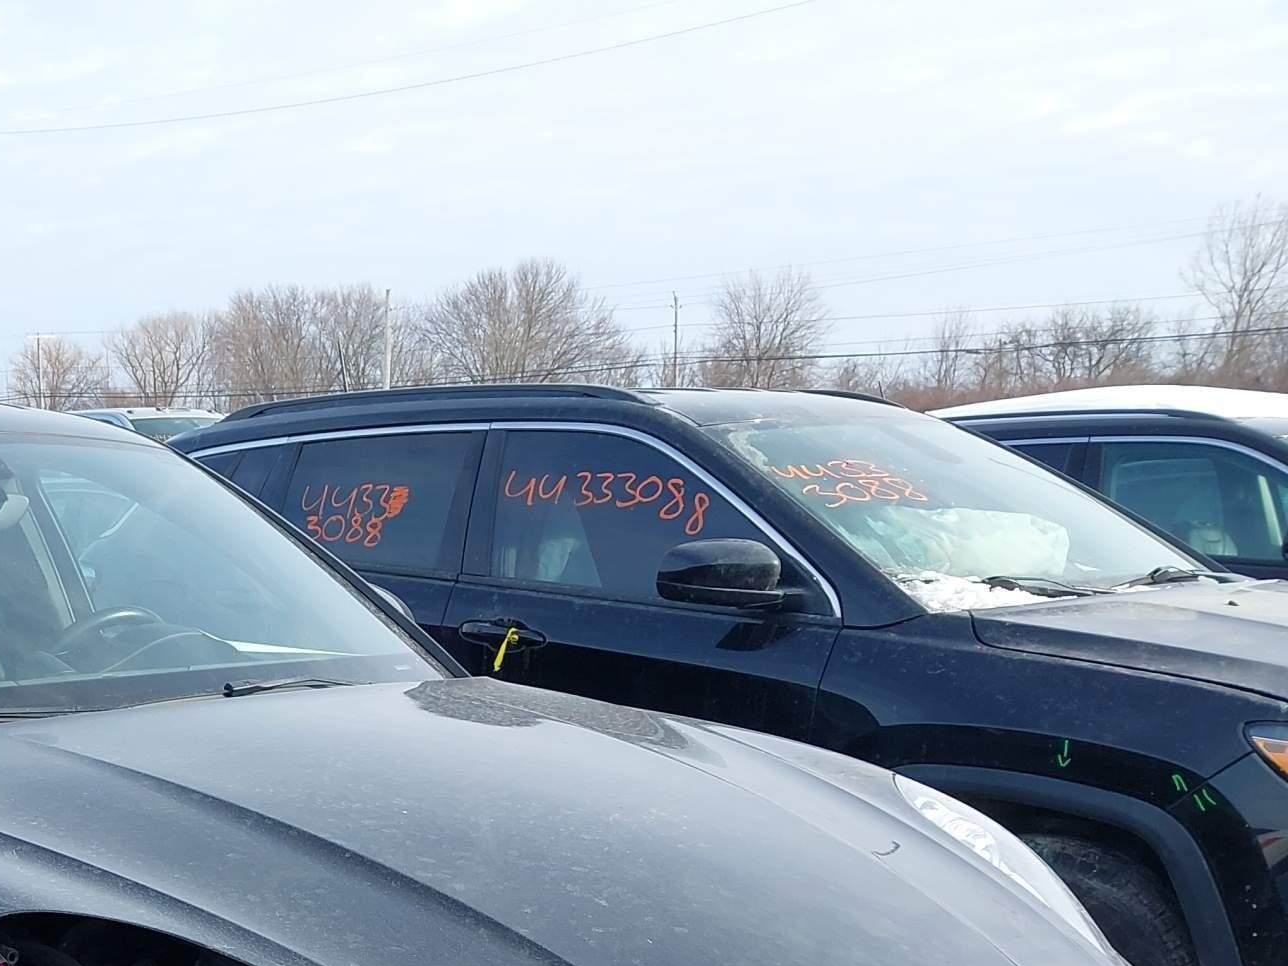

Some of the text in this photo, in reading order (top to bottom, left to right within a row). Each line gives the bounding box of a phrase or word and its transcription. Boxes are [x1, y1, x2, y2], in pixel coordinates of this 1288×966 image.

[503, 470, 711, 536] 44333088
[801, 476, 929, 509] 3088
[306, 508, 383, 548] 3088
